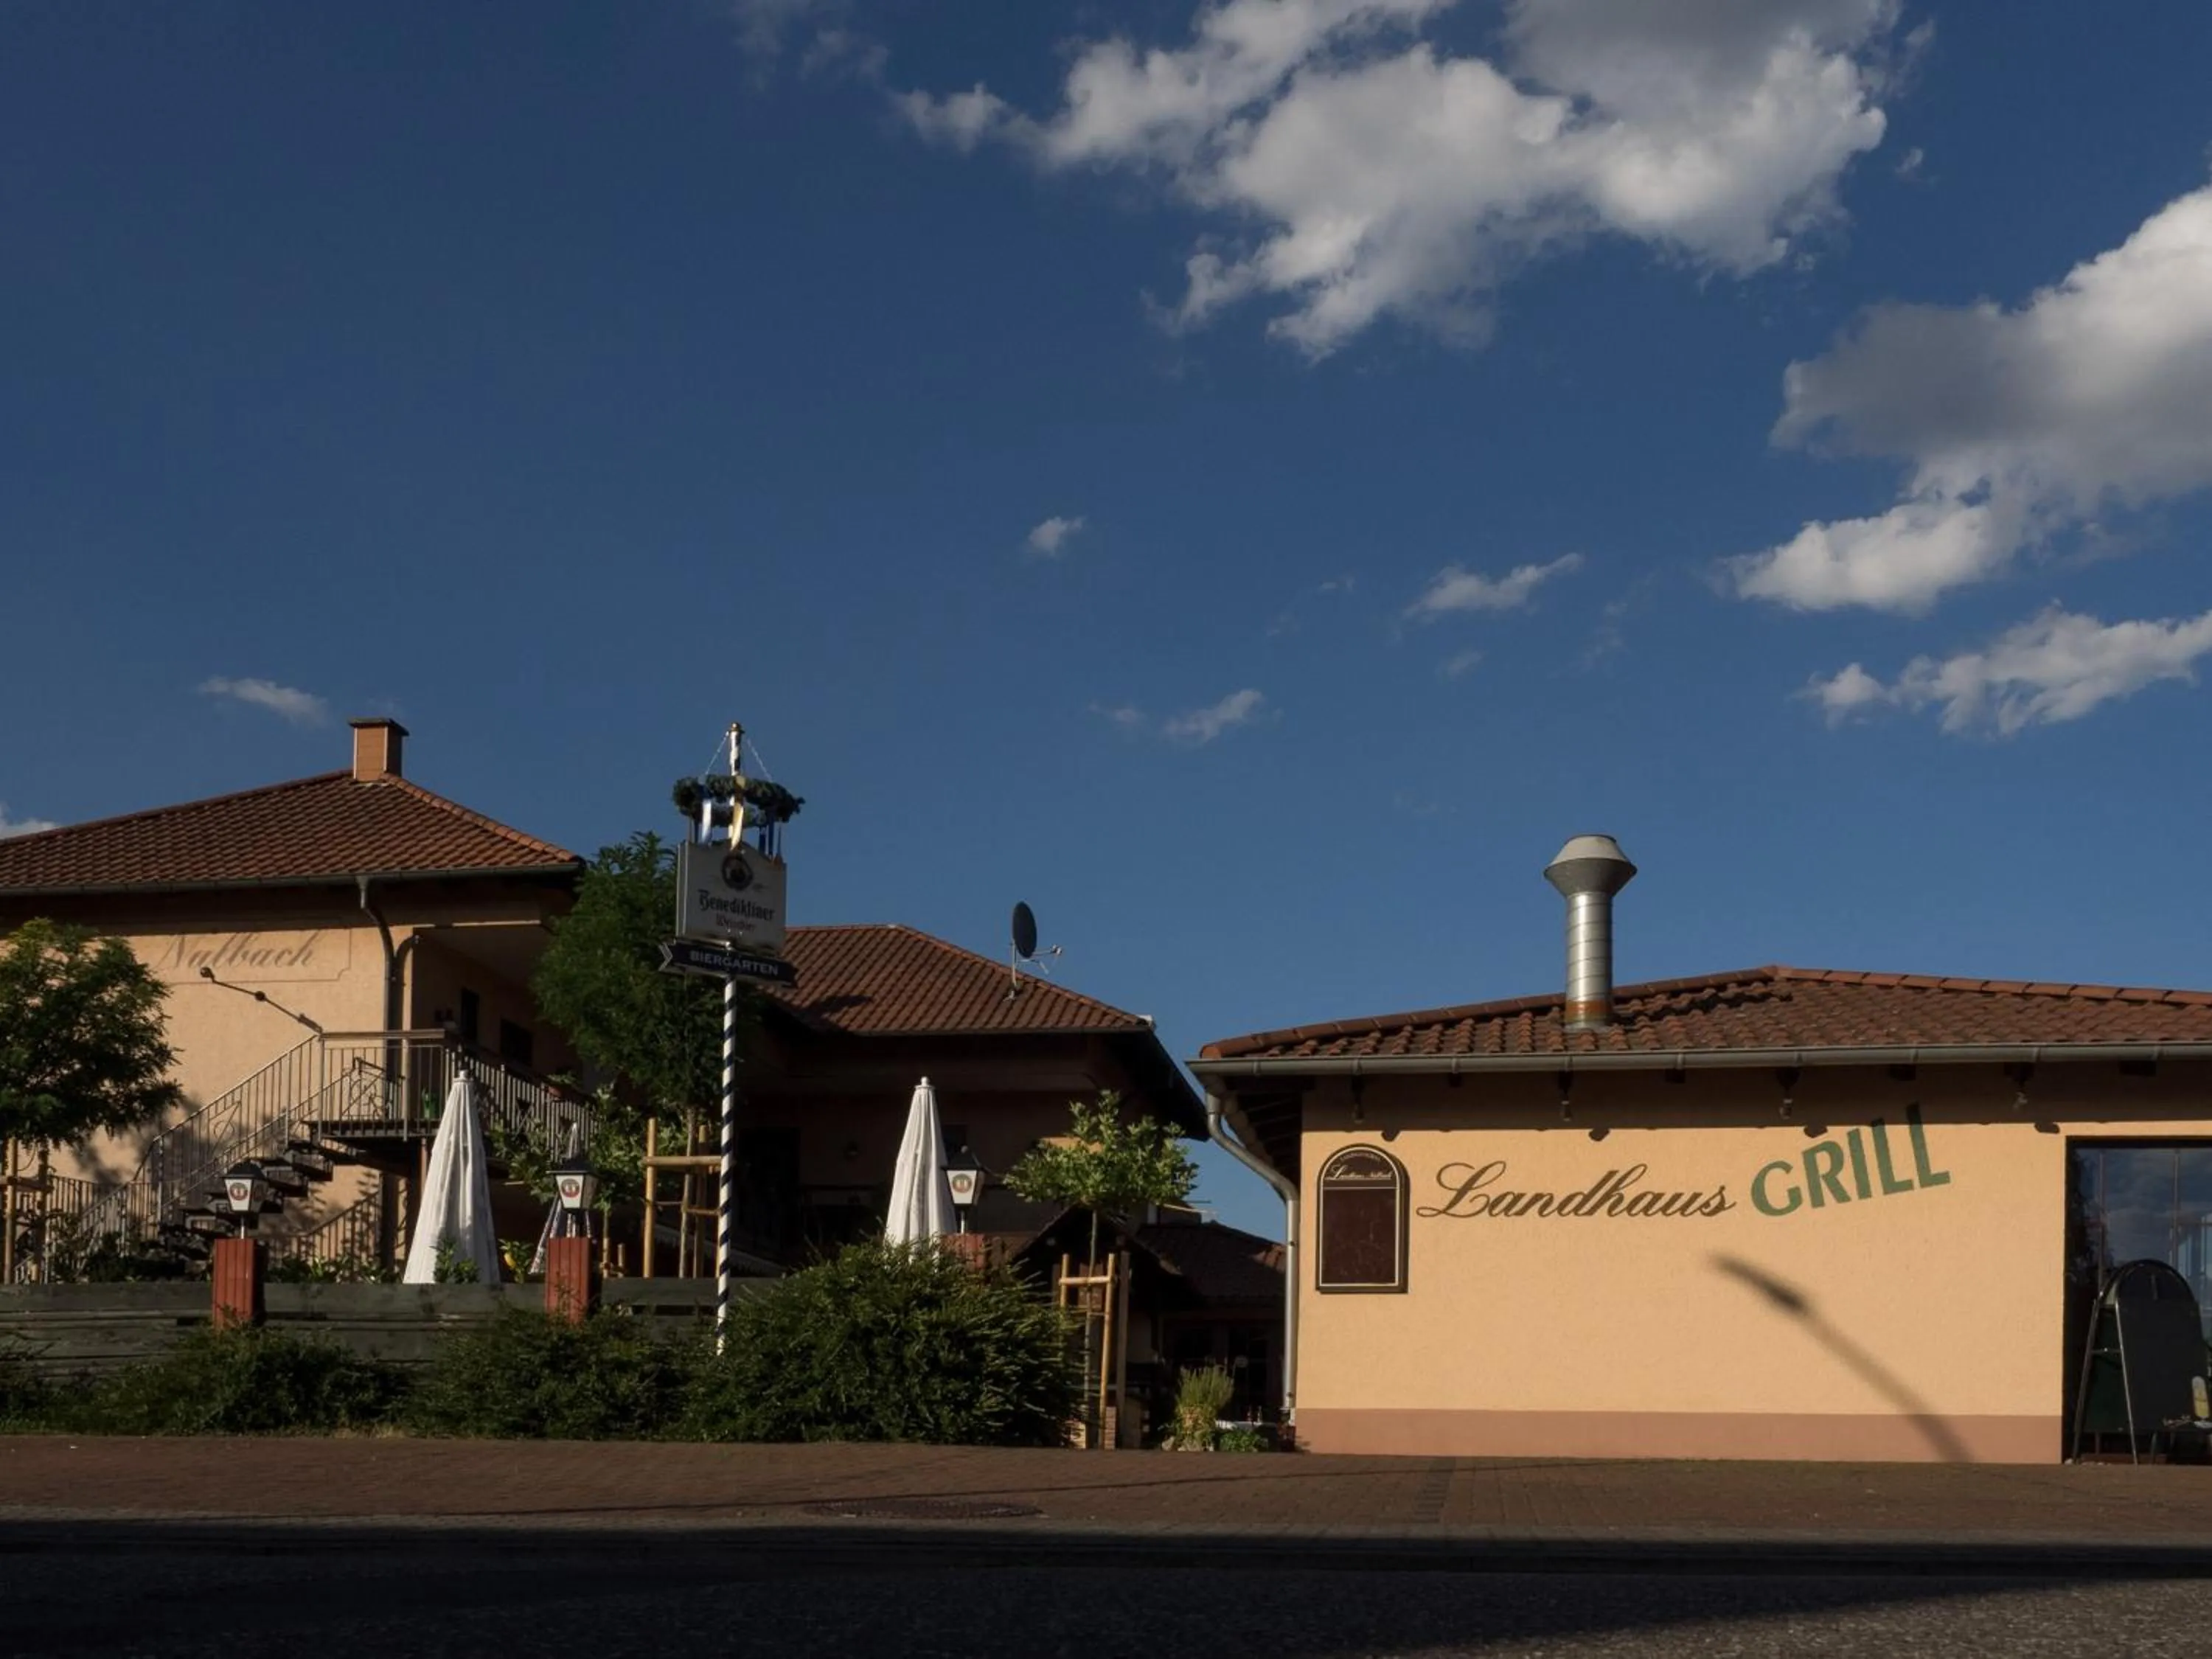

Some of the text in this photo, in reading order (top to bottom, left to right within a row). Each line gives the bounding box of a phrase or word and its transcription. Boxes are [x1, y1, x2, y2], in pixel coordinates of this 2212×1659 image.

[155, 929, 322, 969] Nalbach
[689, 949, 779, 976] BIERGARTEN
[1416, 1101, 1951, 1219] Landhaus GRILL
